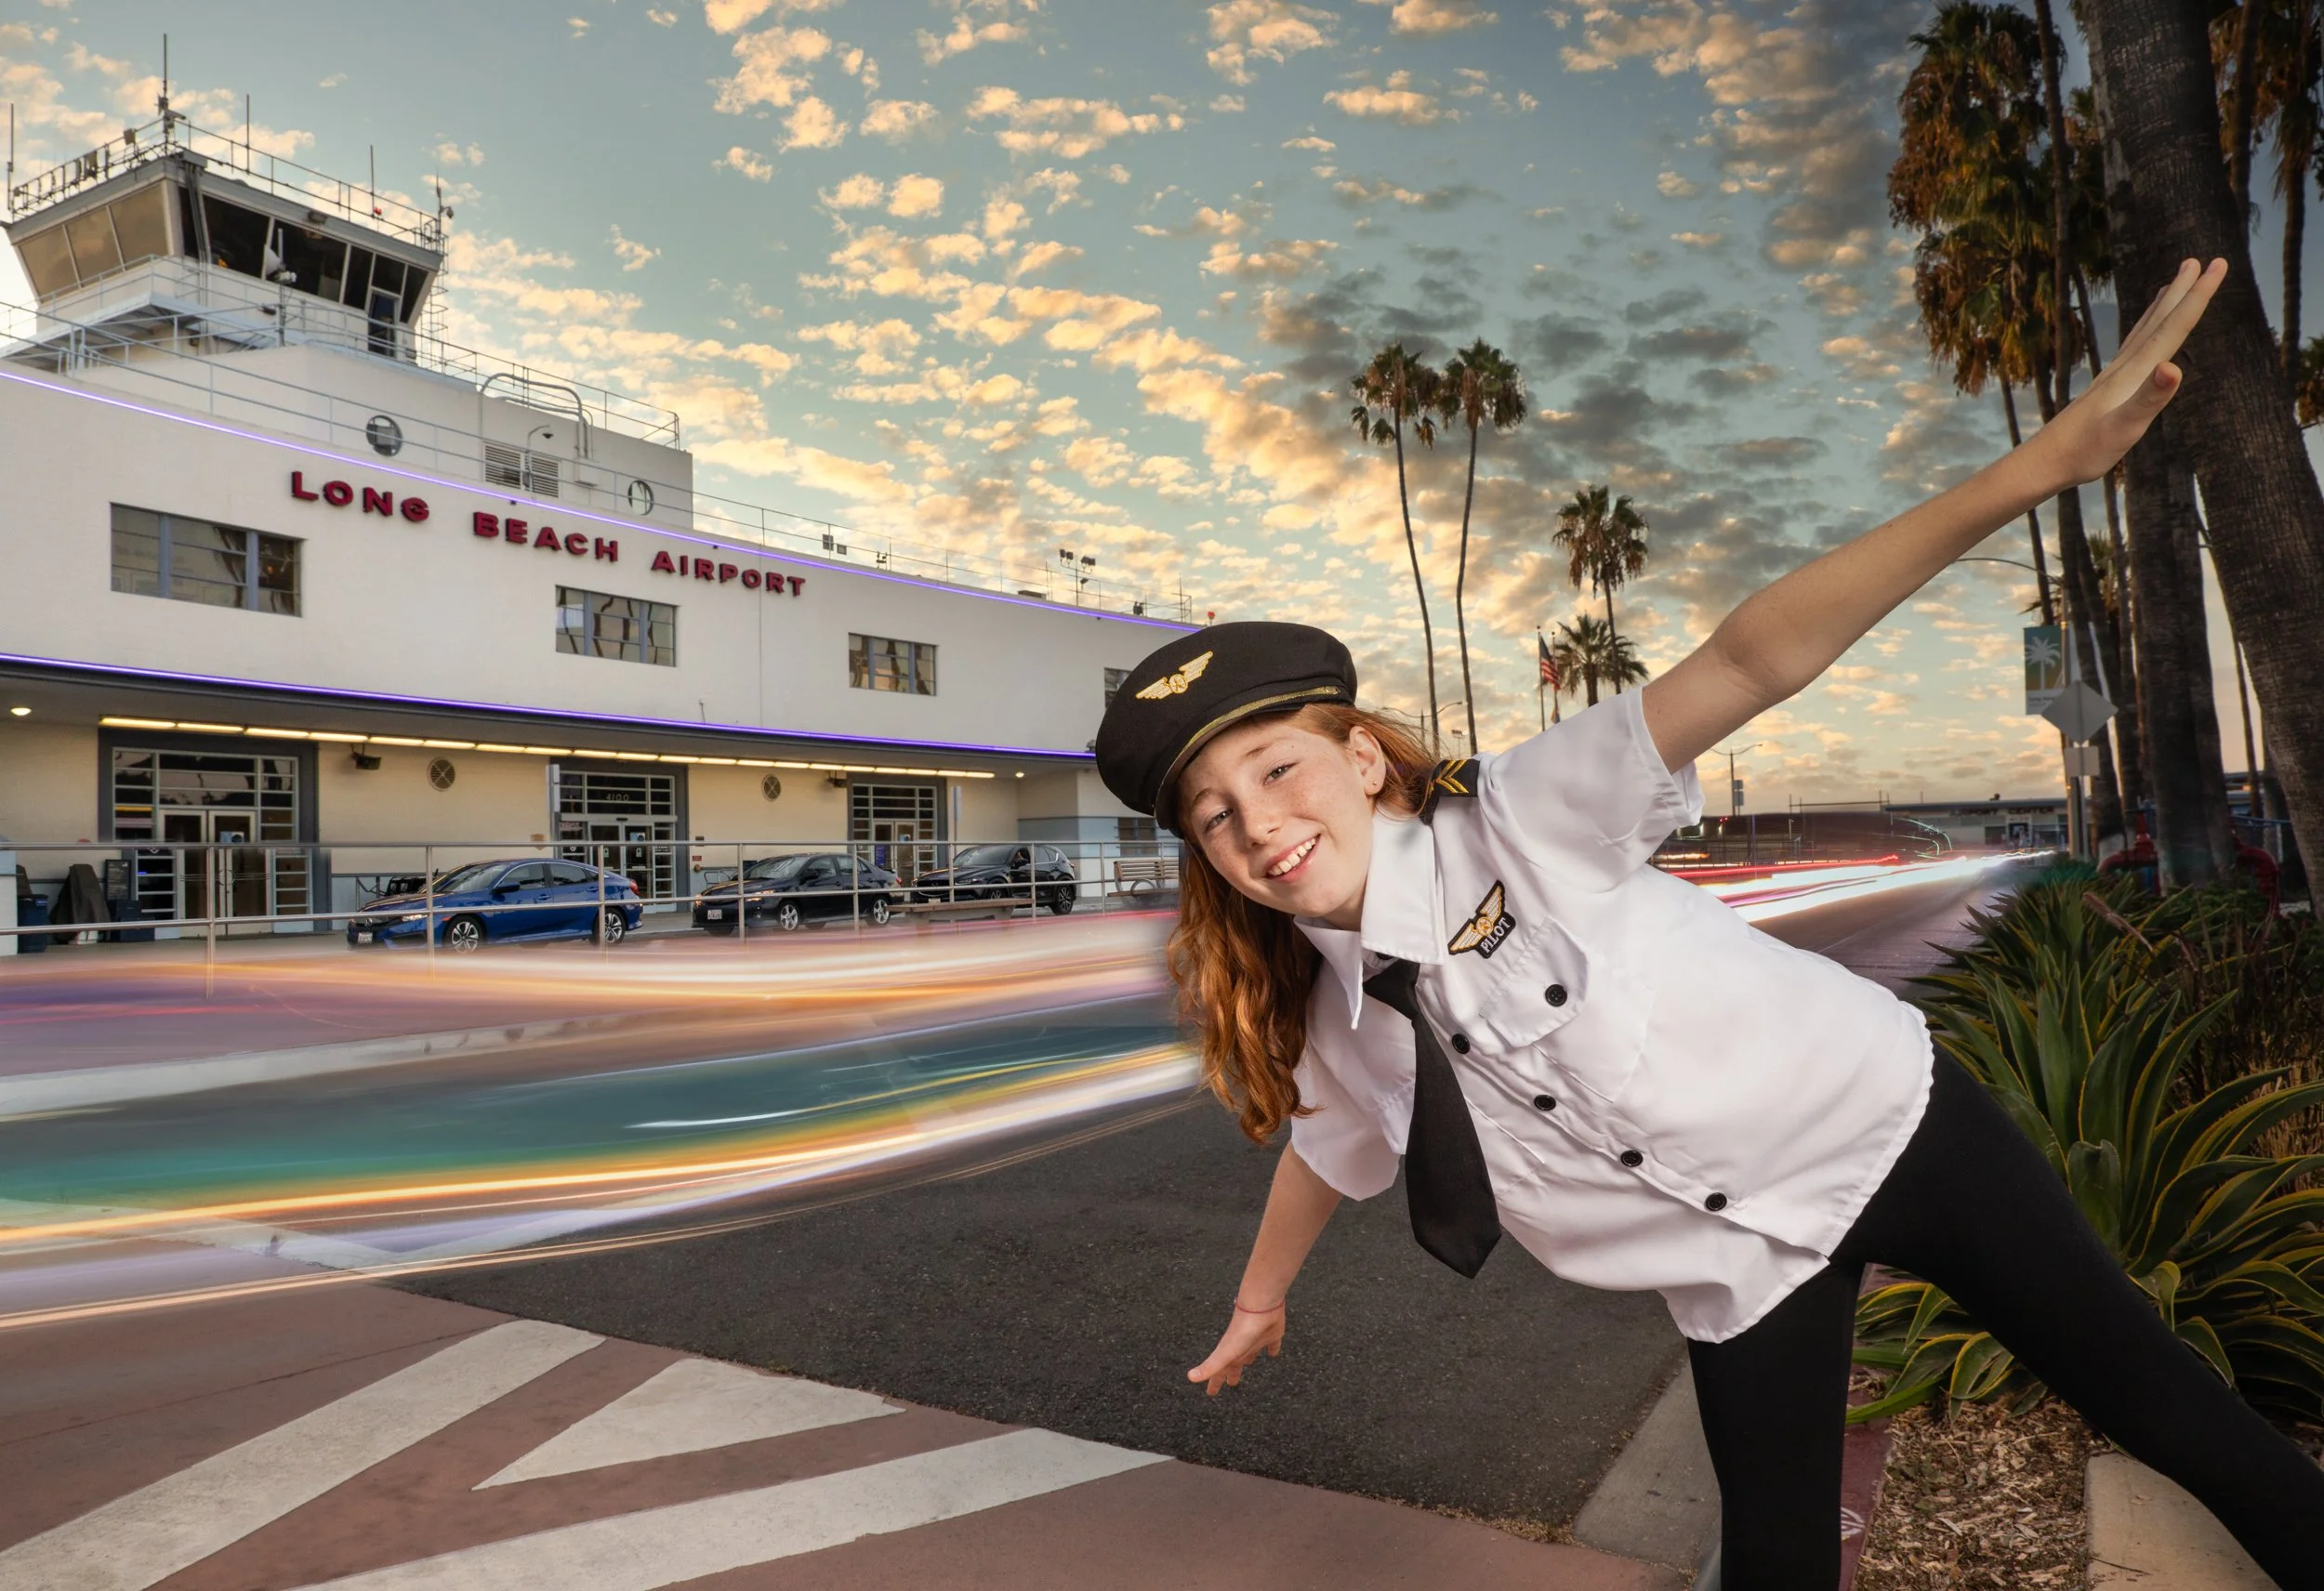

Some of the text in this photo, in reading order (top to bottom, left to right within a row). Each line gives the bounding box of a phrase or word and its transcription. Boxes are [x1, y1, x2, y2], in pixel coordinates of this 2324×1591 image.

[291, 471, 806, 597] LONG BEACH AIRPORT
[606, 793, 630, 802] 4100
[1480, 916, 1511, 953] PILOT
